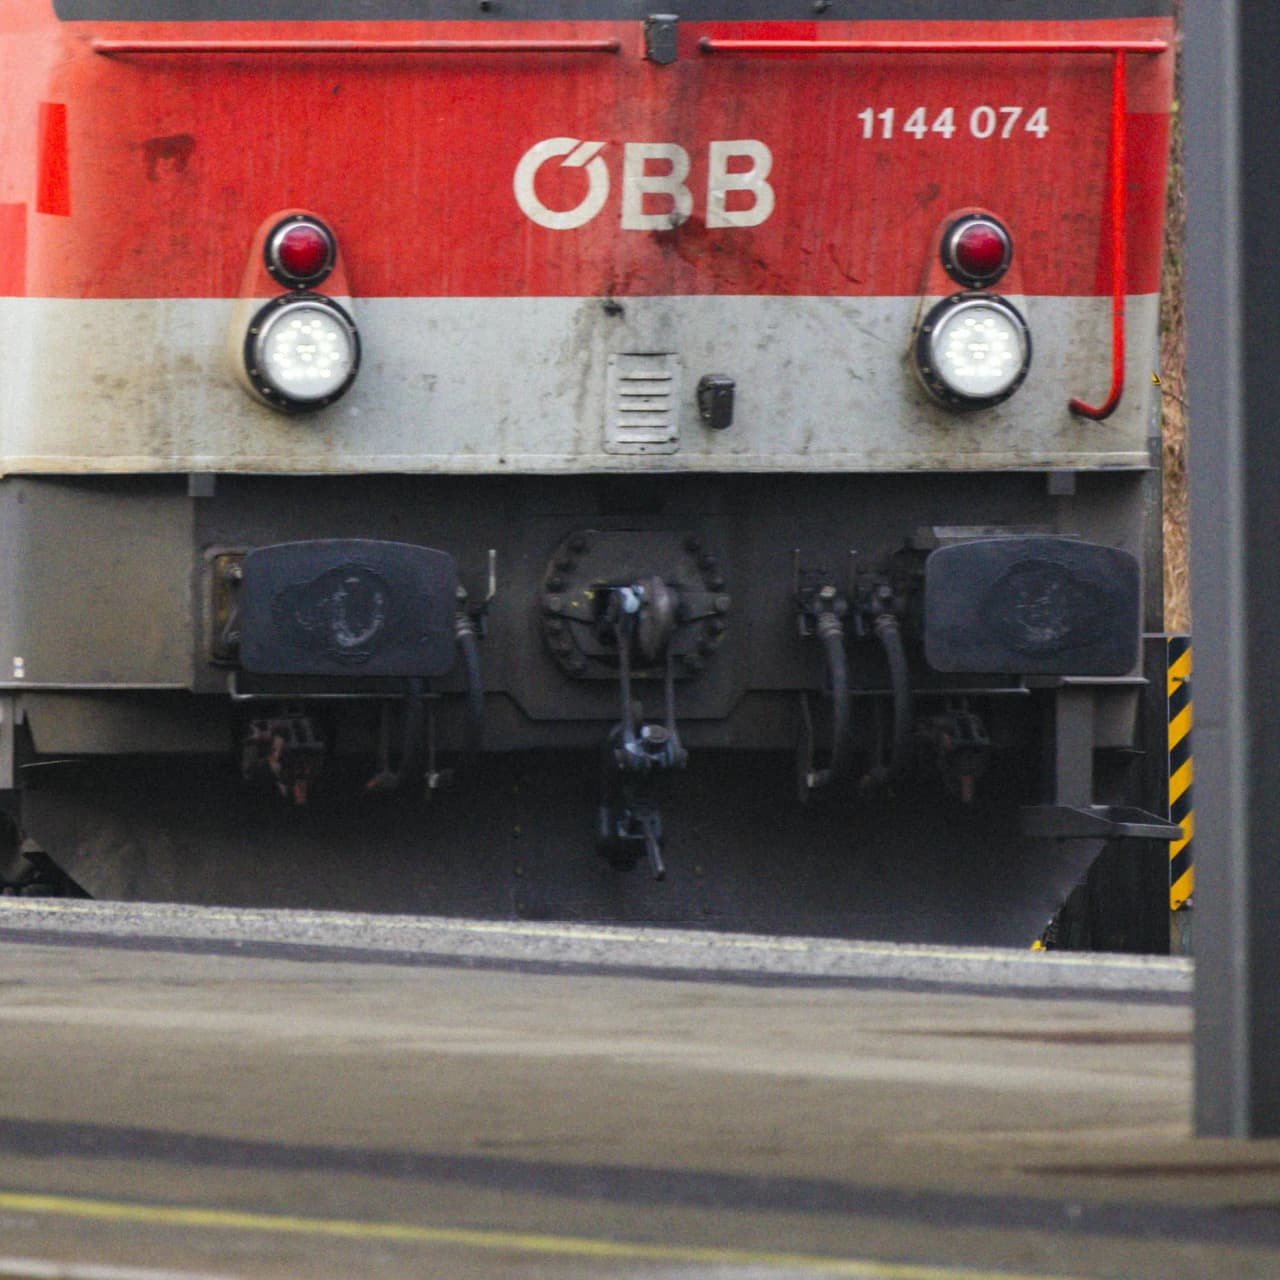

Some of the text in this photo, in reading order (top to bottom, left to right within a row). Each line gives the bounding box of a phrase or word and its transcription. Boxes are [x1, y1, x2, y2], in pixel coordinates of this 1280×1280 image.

[856, 105, 1050, 140] 1144 074
[512, 136, 776, 230] ÖBB
